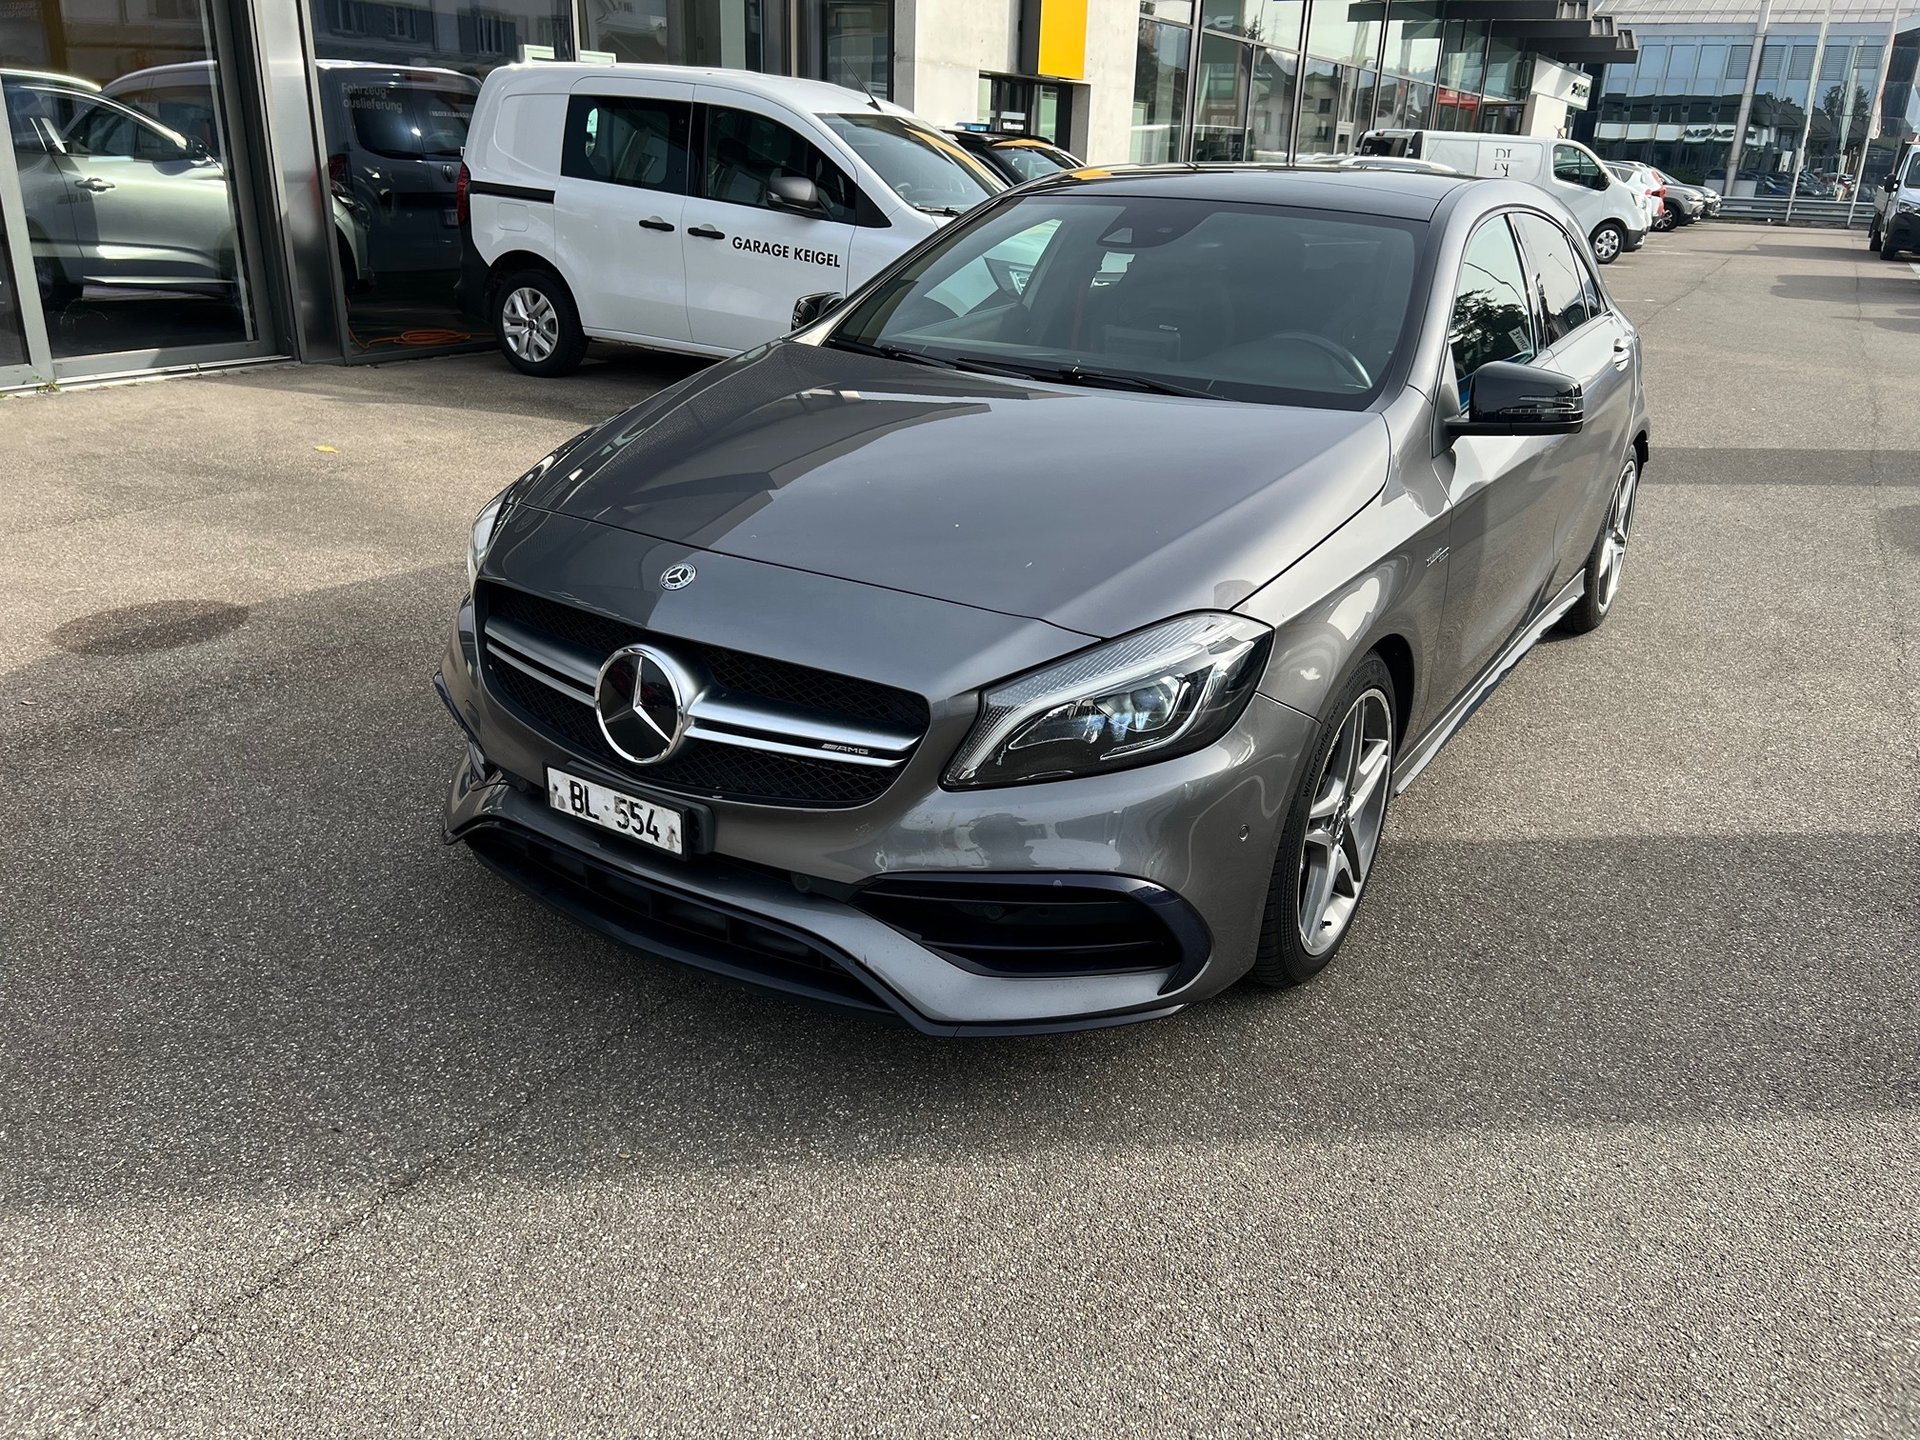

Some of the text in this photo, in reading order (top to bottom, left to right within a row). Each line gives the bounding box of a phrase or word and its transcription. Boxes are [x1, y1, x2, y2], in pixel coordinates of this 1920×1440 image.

[341, 82, 390, 99] Fahrzeug-
[343, 98, 403, 114] auslieferung
[732, 236, 841, 268] GARAGE KEIGEL
[837, 745, 869, 755] AMG
[1302, 723, 1333, 798] WinterContact
[569, 780, 660, 842] BL 554
